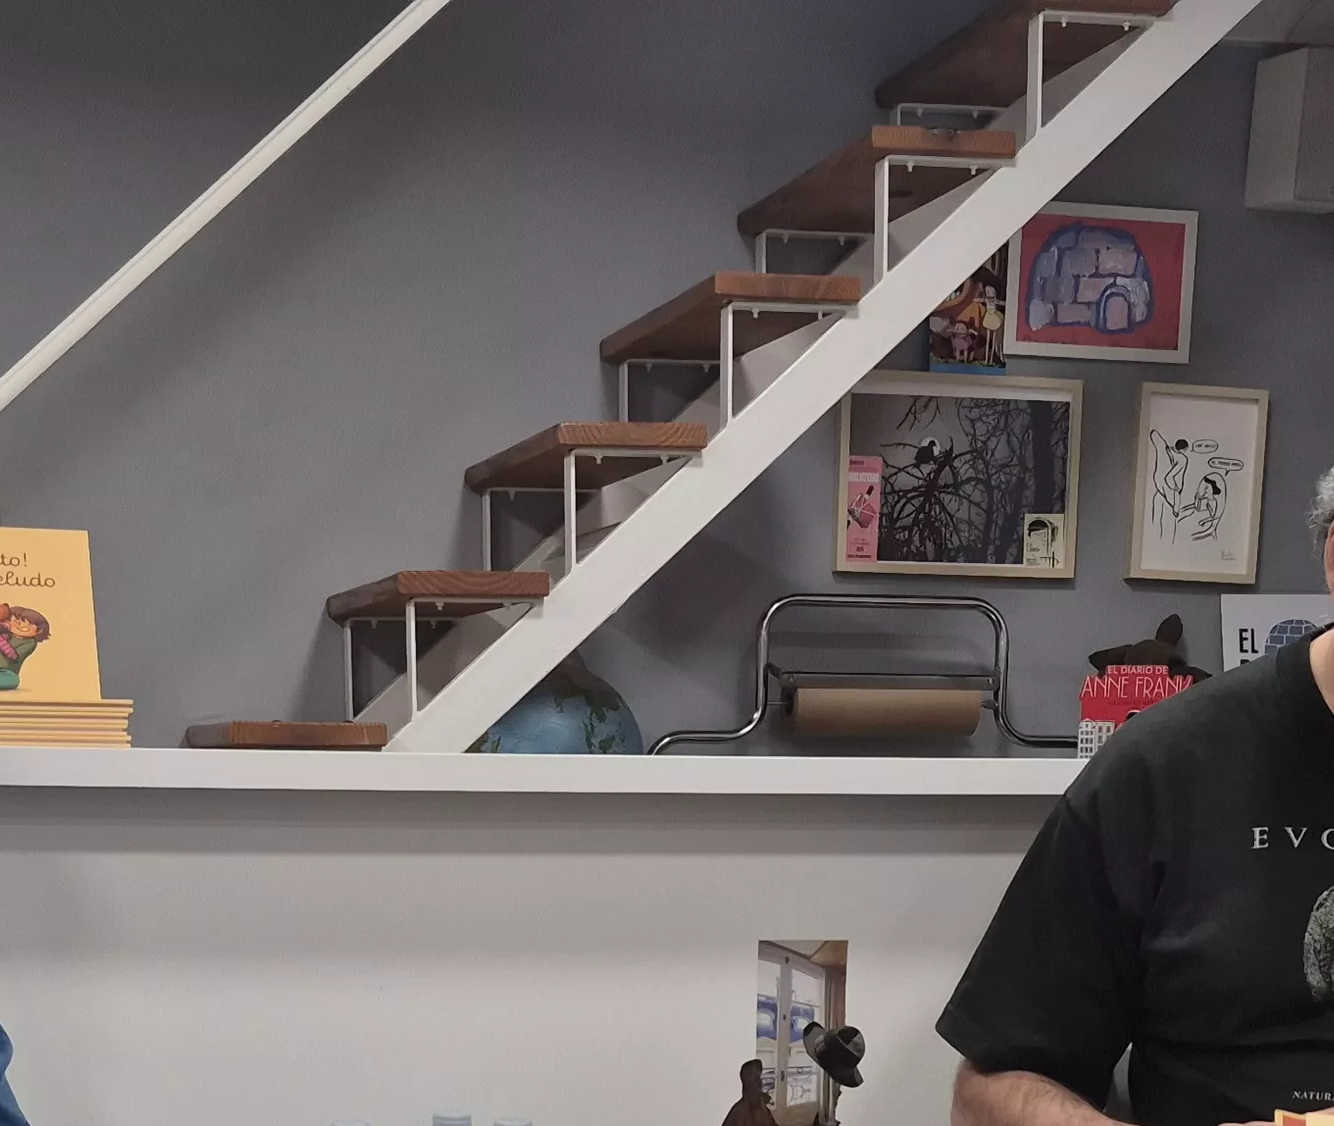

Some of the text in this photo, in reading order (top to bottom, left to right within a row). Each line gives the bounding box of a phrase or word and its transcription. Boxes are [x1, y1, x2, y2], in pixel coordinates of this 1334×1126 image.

[1239, 628, 1259, 654] EL
[1108, 666, 1168, 674] EL DIARIO DE
[1082, 675, 1129, 698] ANNE
